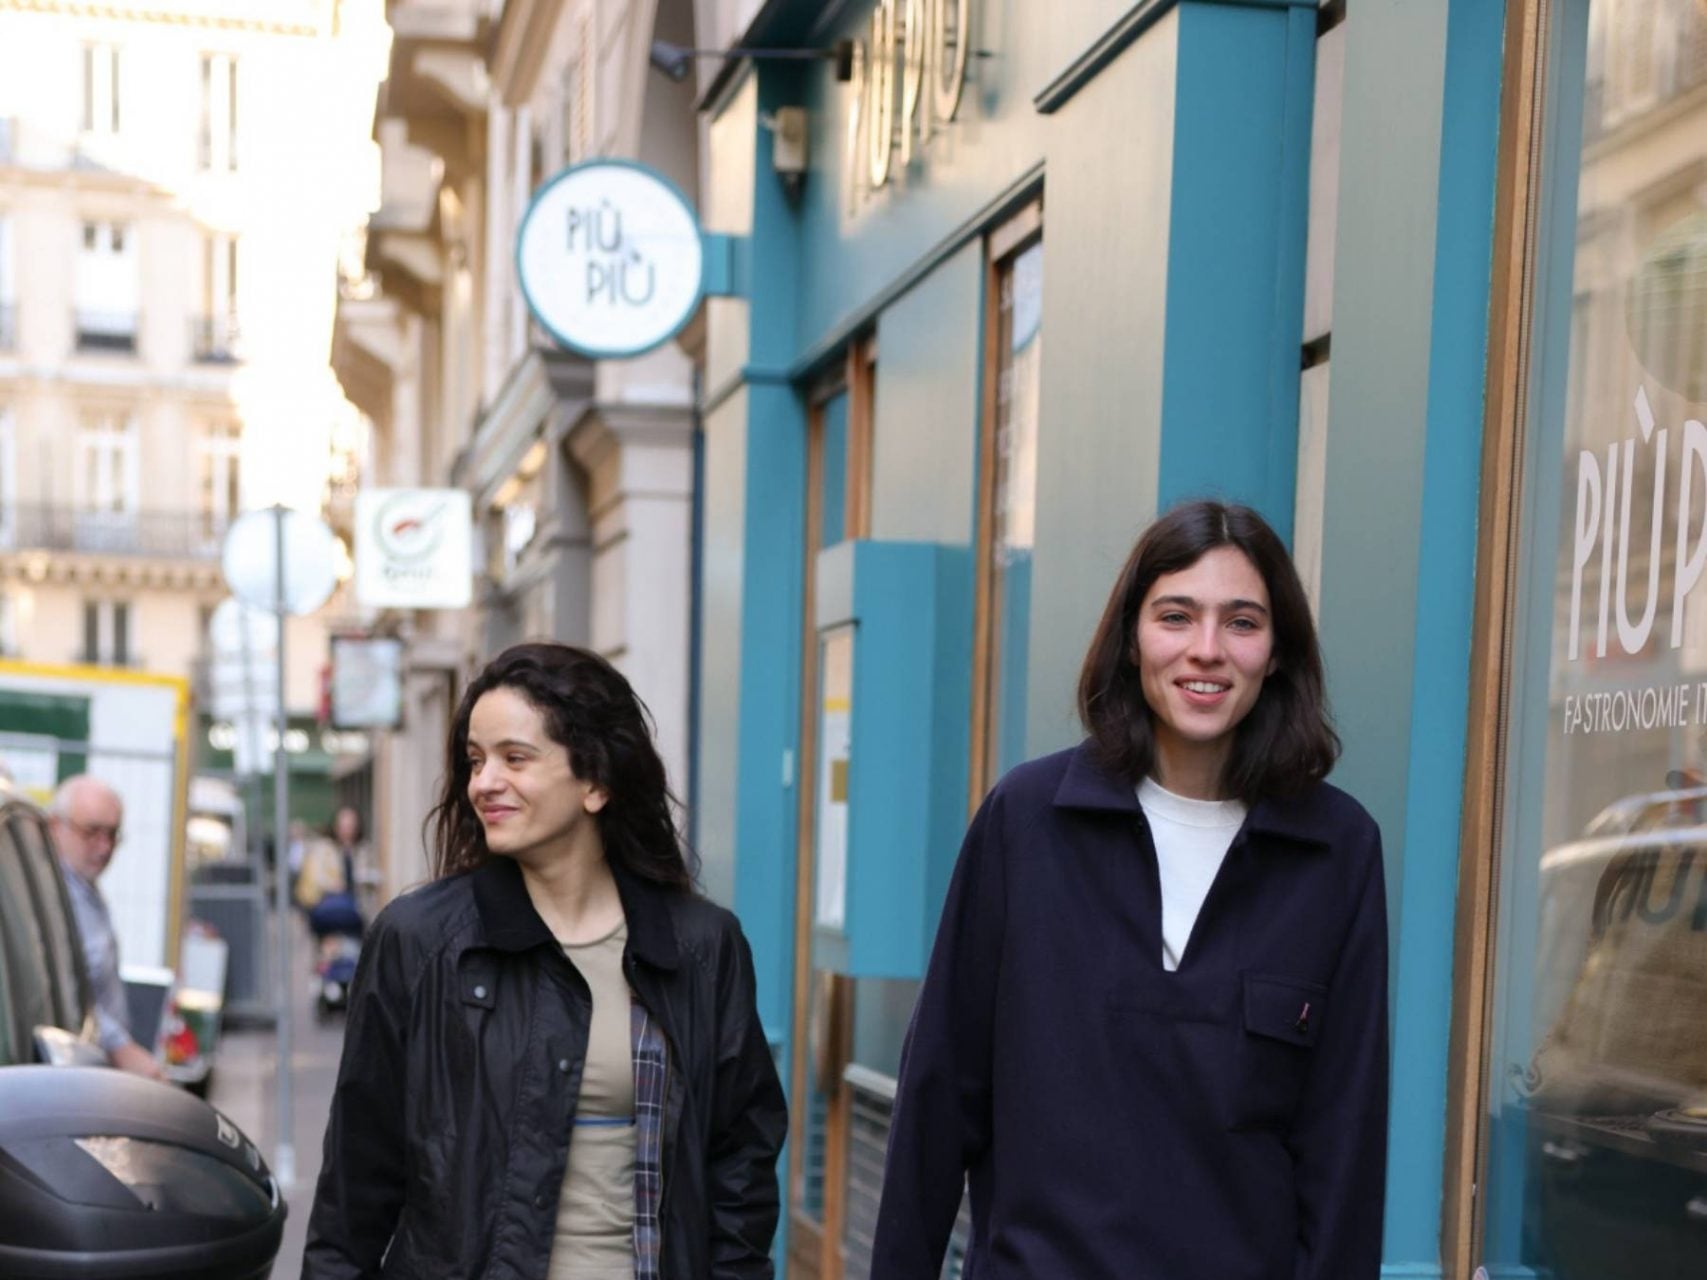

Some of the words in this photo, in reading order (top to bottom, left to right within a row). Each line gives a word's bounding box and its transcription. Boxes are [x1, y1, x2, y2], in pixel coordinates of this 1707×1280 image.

[567, 199, 623, 252] PIÙ
[586, 249, 656, 306] PIÙ
[1563, 683, 1690, 735] FASTRONOMIE
